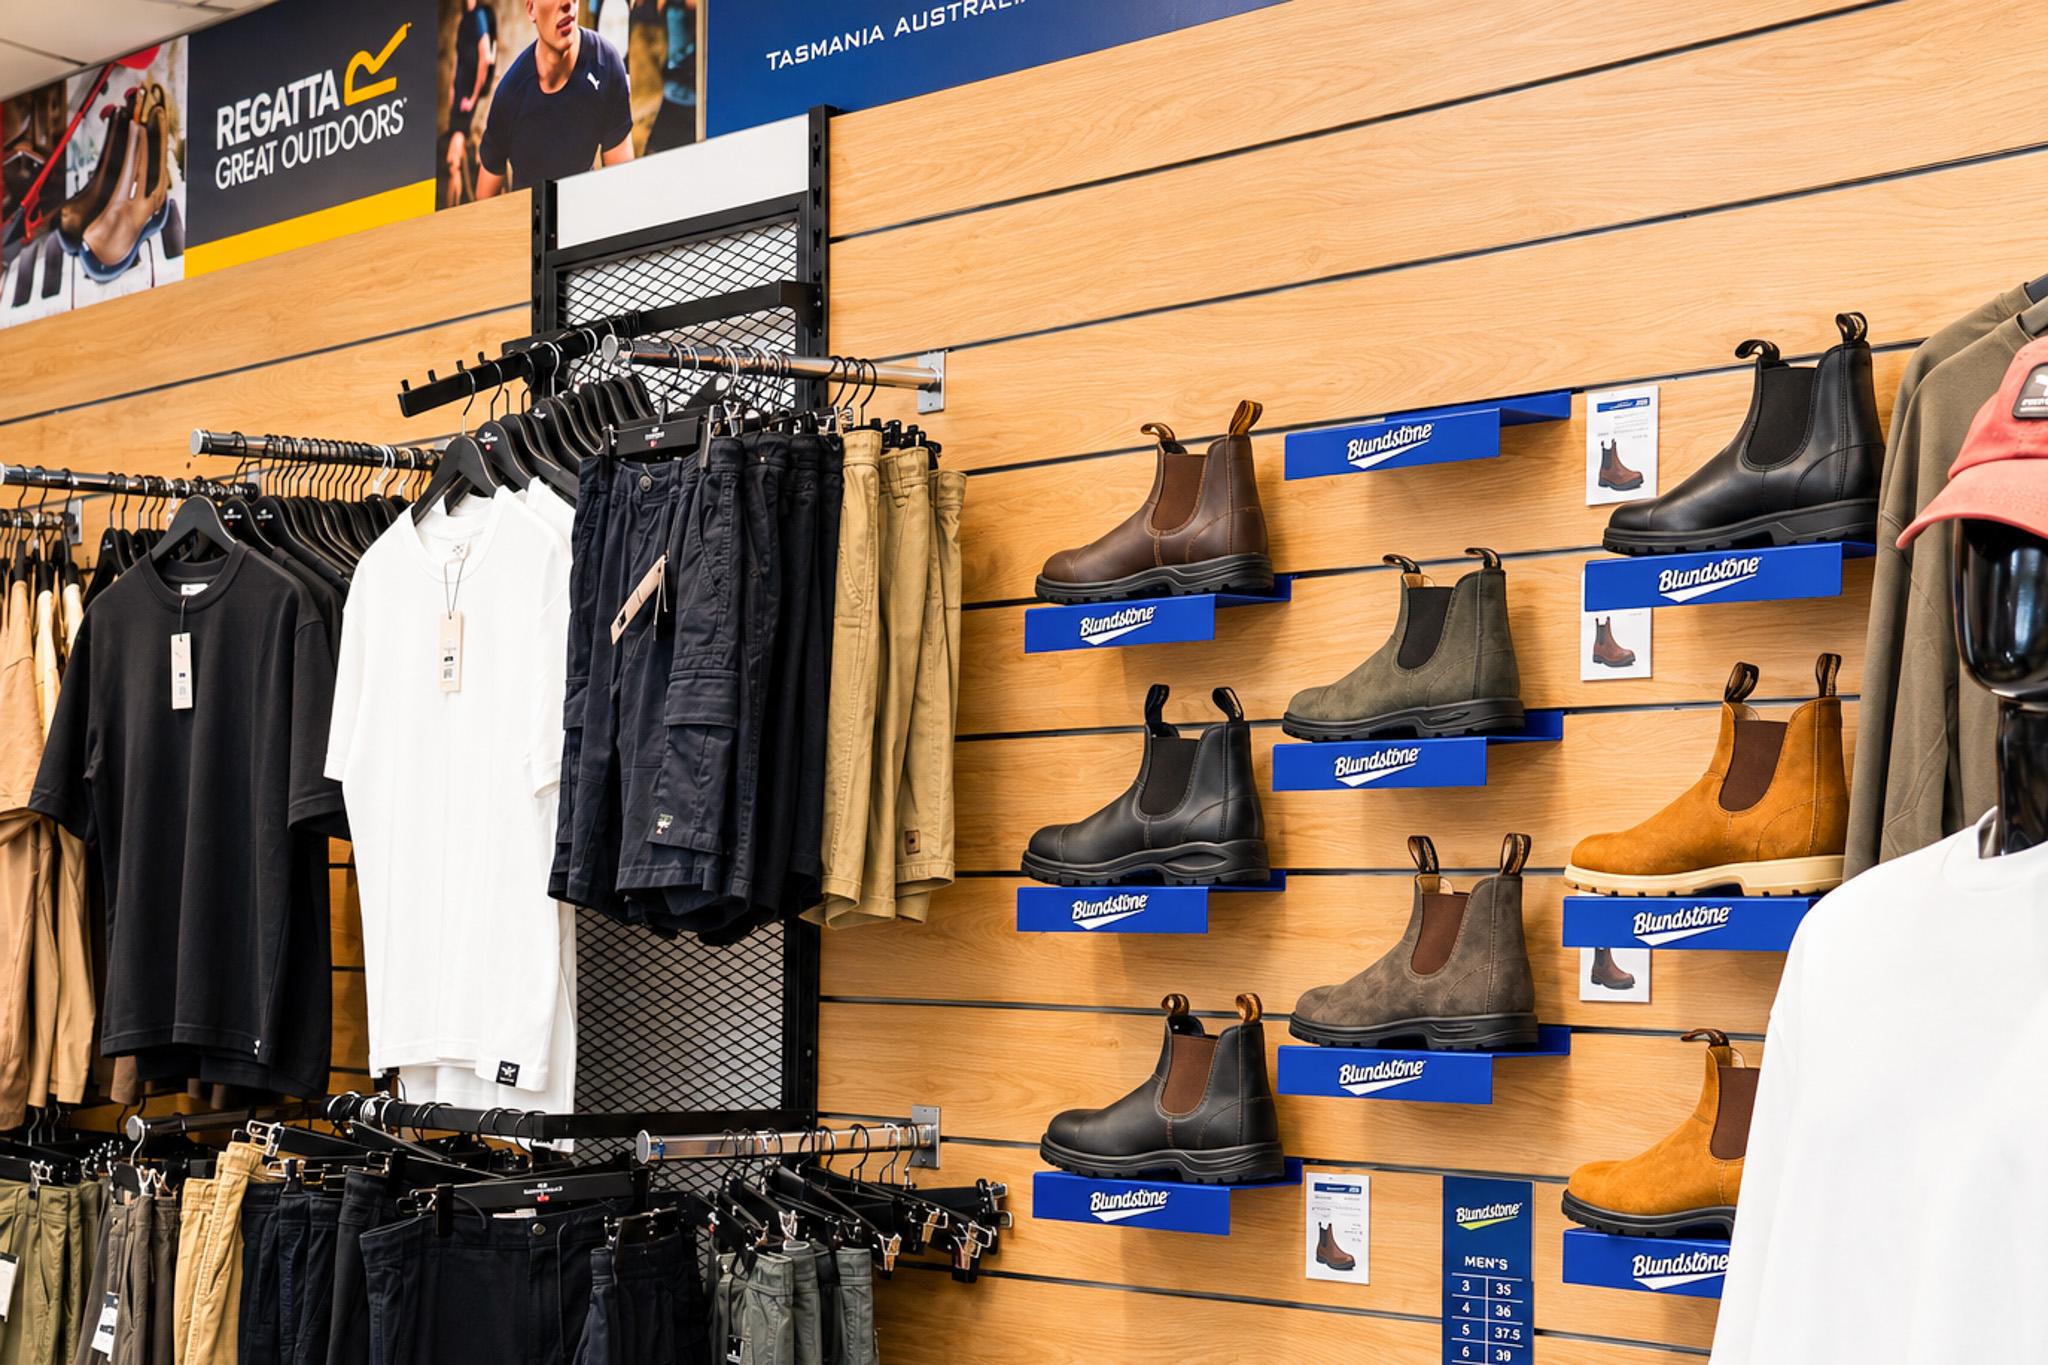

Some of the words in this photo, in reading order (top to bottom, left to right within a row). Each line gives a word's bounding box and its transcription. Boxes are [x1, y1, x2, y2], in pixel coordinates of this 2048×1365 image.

[766, 25, 885, 71] TASMANIA
[894, 0, 1026, 37] AUSTRAL
[217, 69, 340, 151] REGATTA
[215, 140, 278, 190] GREAT
[281, 98, 404, 170] OUTDOORS
[1347, 423, 1432, 461] Blundstone
[1659, 557, 1760, 592] Blundstone
[1080, 606, 1154, 637] Blundstone
[1334, 747, 1419, 777] Blundstone
[1072, 894, 1147, 920] Blundstone
[1633, 906, 1729, 935] Blundstone
[1339, 1060, 1424, 1085] Blundstone
[1090, 1189, 1167, 1212] Blundstone
[1456, 1203, 1520, 1223] Blundstone
[1464, 1256, 1508, 1271] MEN'S
[1632, 1251, 1729, 1277] Blundstone
[1462, 1279, 1470, 1292] 3
[1496, 1284, 1511, 1296] 35
[1462, 1302, 1470, 1313] 4
[1495, 1305, 1511, 1317] 36
[1462, 1323, 1470, 1336] 5
[1494, 1326, 1521, 1341] 37.5
[1462, 1346, 1470, 1358] 6
